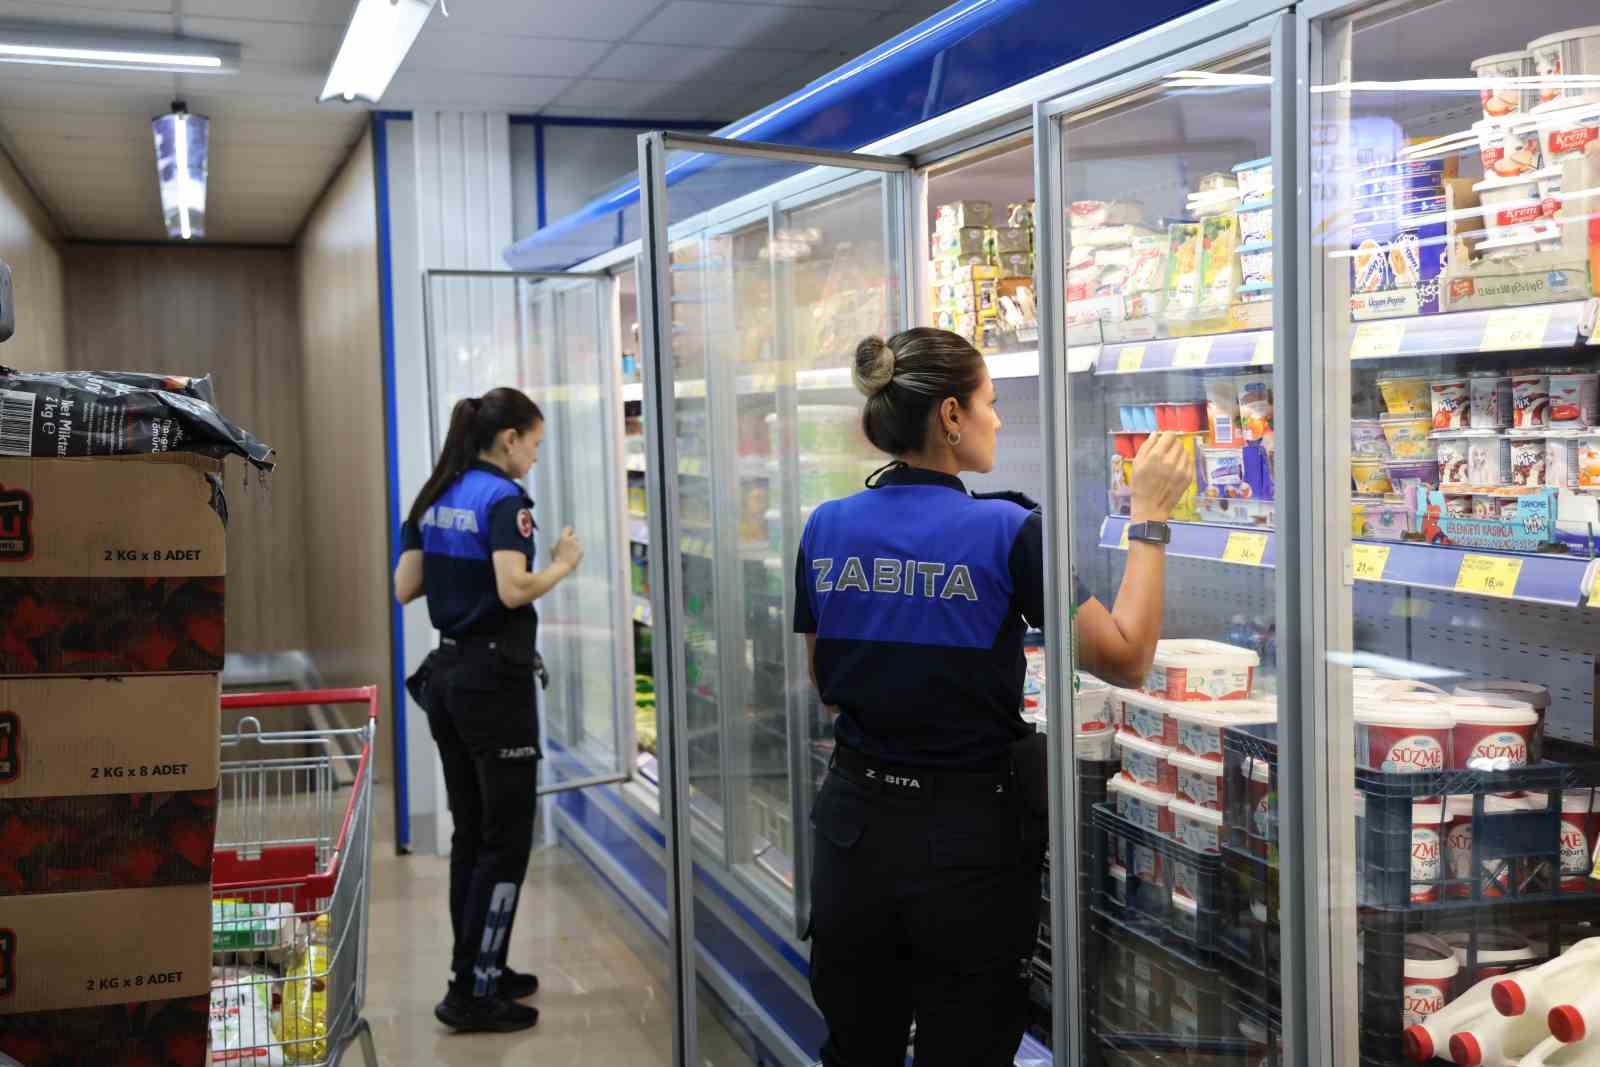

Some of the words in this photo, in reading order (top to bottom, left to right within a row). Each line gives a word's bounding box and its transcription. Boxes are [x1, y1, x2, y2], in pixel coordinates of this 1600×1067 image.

[40, 402, 59, 419] kg
[59, 399, 76, 417] Net
[418, 505, 479, 534] ABITA
[104, 550, 113, 561] 2
[117, 550, 137, 561] KG
[141, 553, 149, 561] x
[153, 550, 161, 561] 8
[165, 549, 202, 561] ADET
[812, 556, 978, 601] ZABITA
[1392, 746, 1440, 768] SÜZME
[1477, 744, 1526, 763] SÜZME
[90, 768, 99, 779] 2
[104, 767, 123, 778] KG
[127, 769, 136, 777] x
[140, 765, 148, 776] 8
[152, 763, 189, 776] ADET
[865, 768, 921, 788] ZBITA
[87, 980, 95, 991] 2
[100, 978, 119, 990] KG
[123, 980, 131, 988] x
[135, 975, 143, 986] 8
[147, 971, 183, 985] ADET
